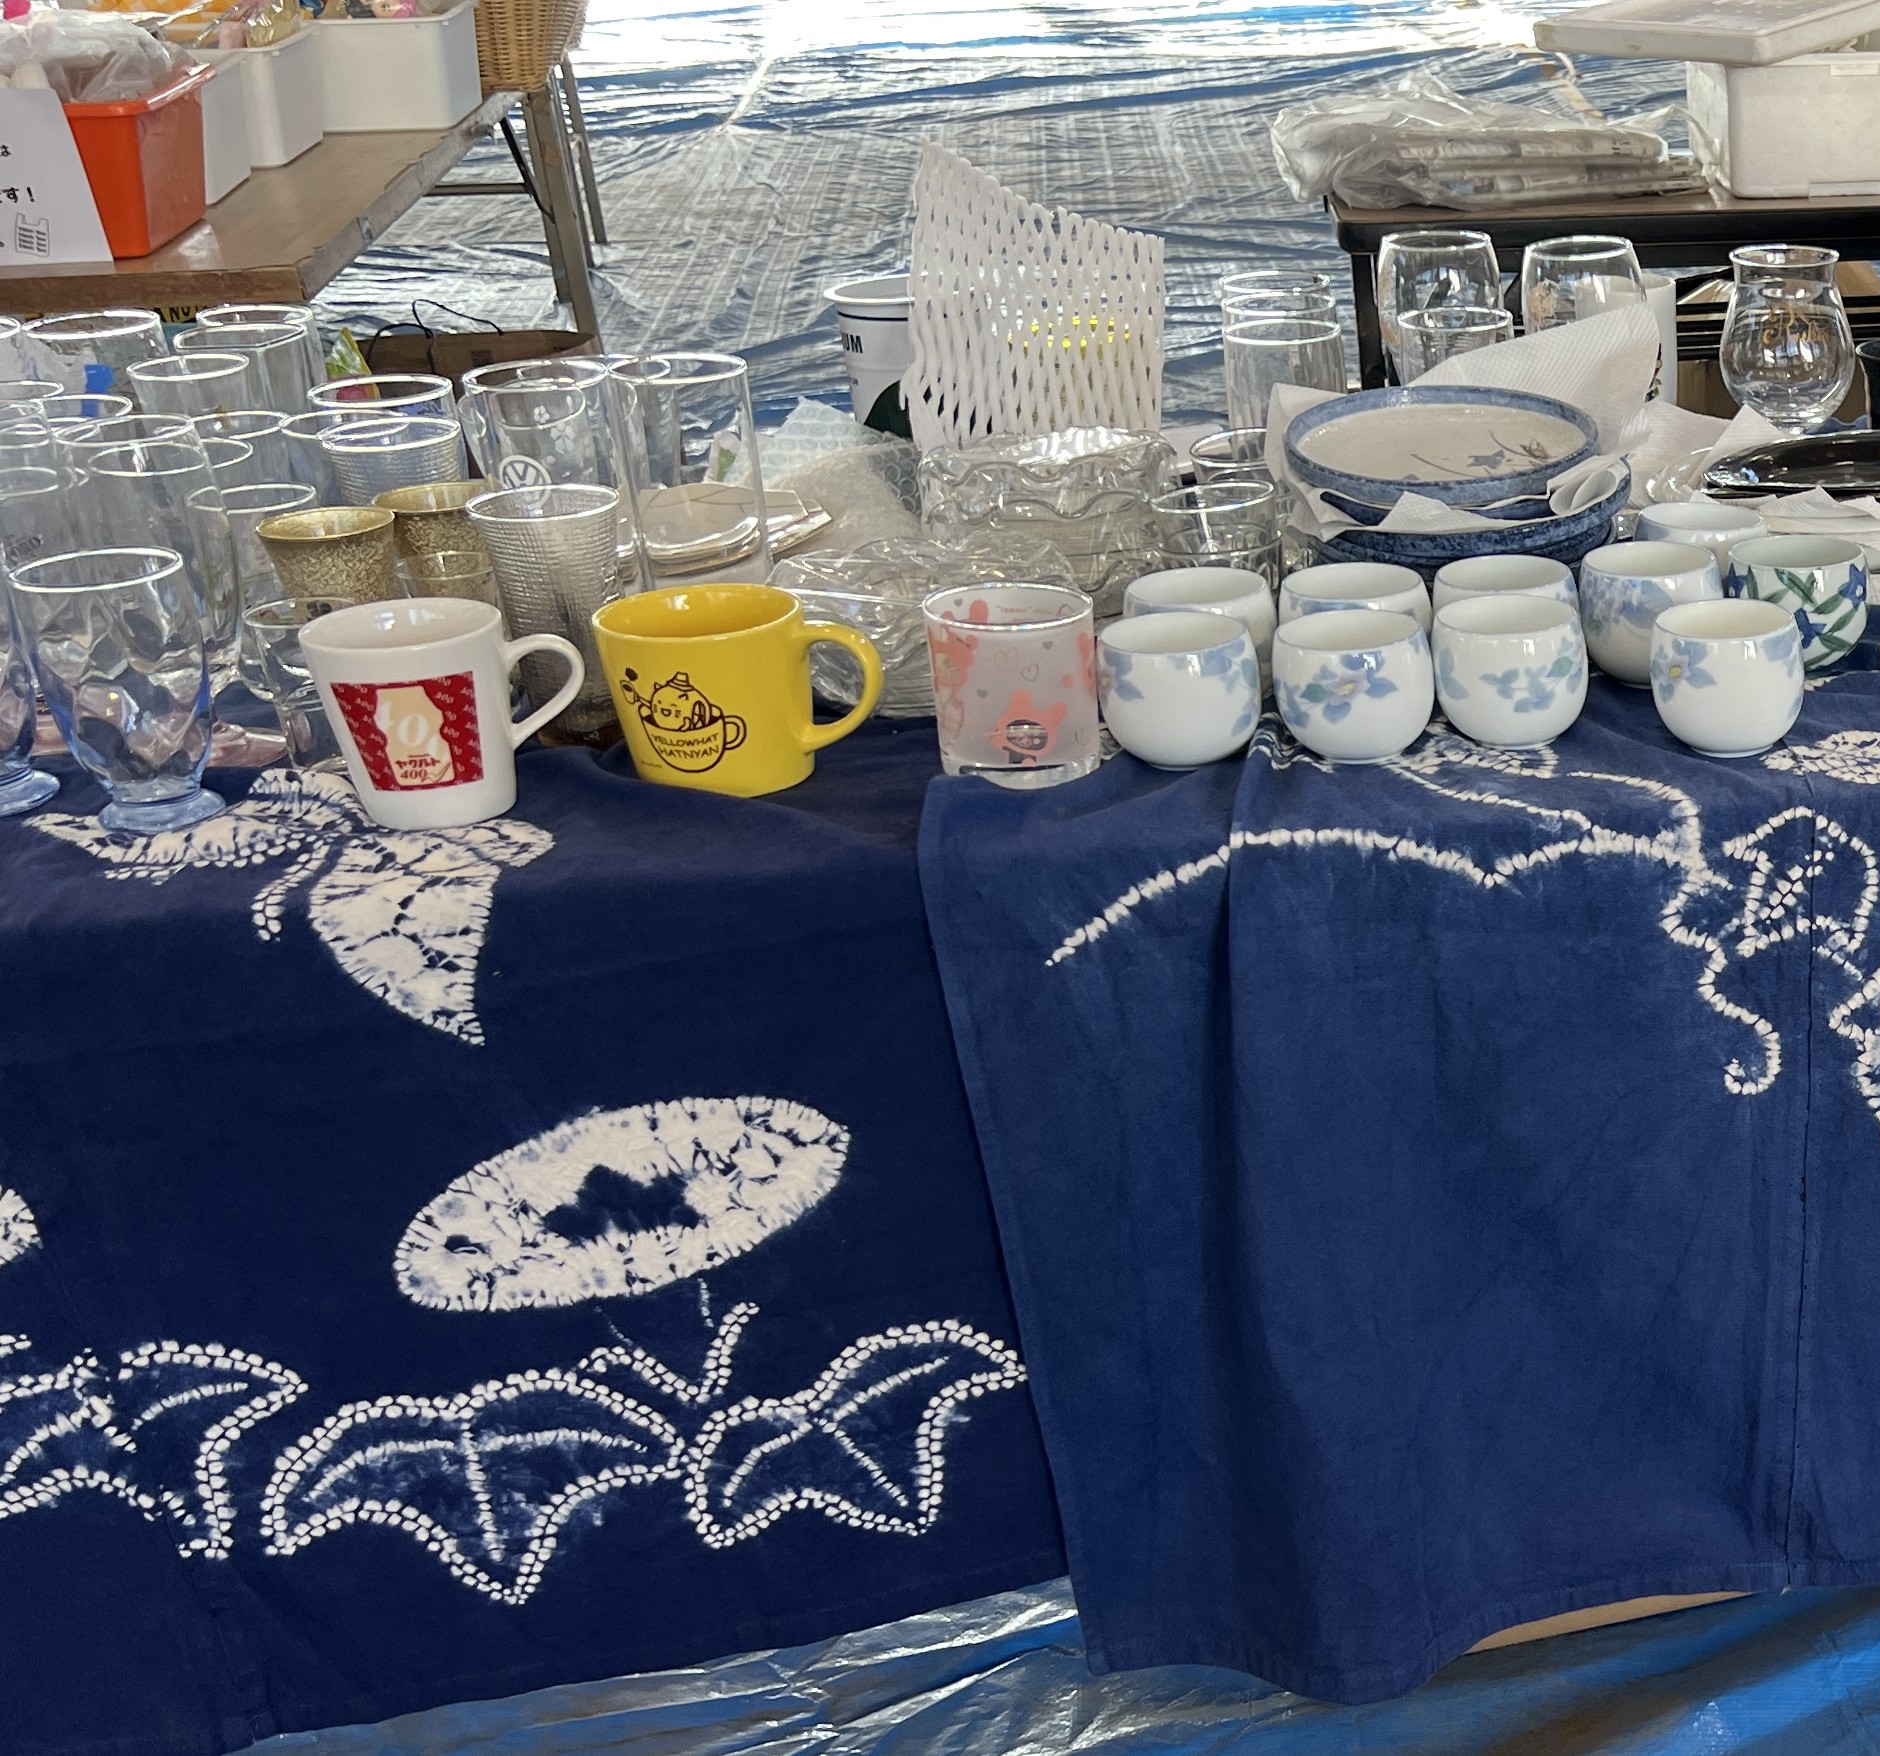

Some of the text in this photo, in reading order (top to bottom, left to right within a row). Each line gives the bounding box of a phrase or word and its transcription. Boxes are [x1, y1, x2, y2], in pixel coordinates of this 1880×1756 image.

[651, 733, 720, 748] YELLOWHAT
[659, 745, 719, 760] HATNYAN
[395, 757, 441, 770] ヤクルト
[400, 768, 428, 780] 400
